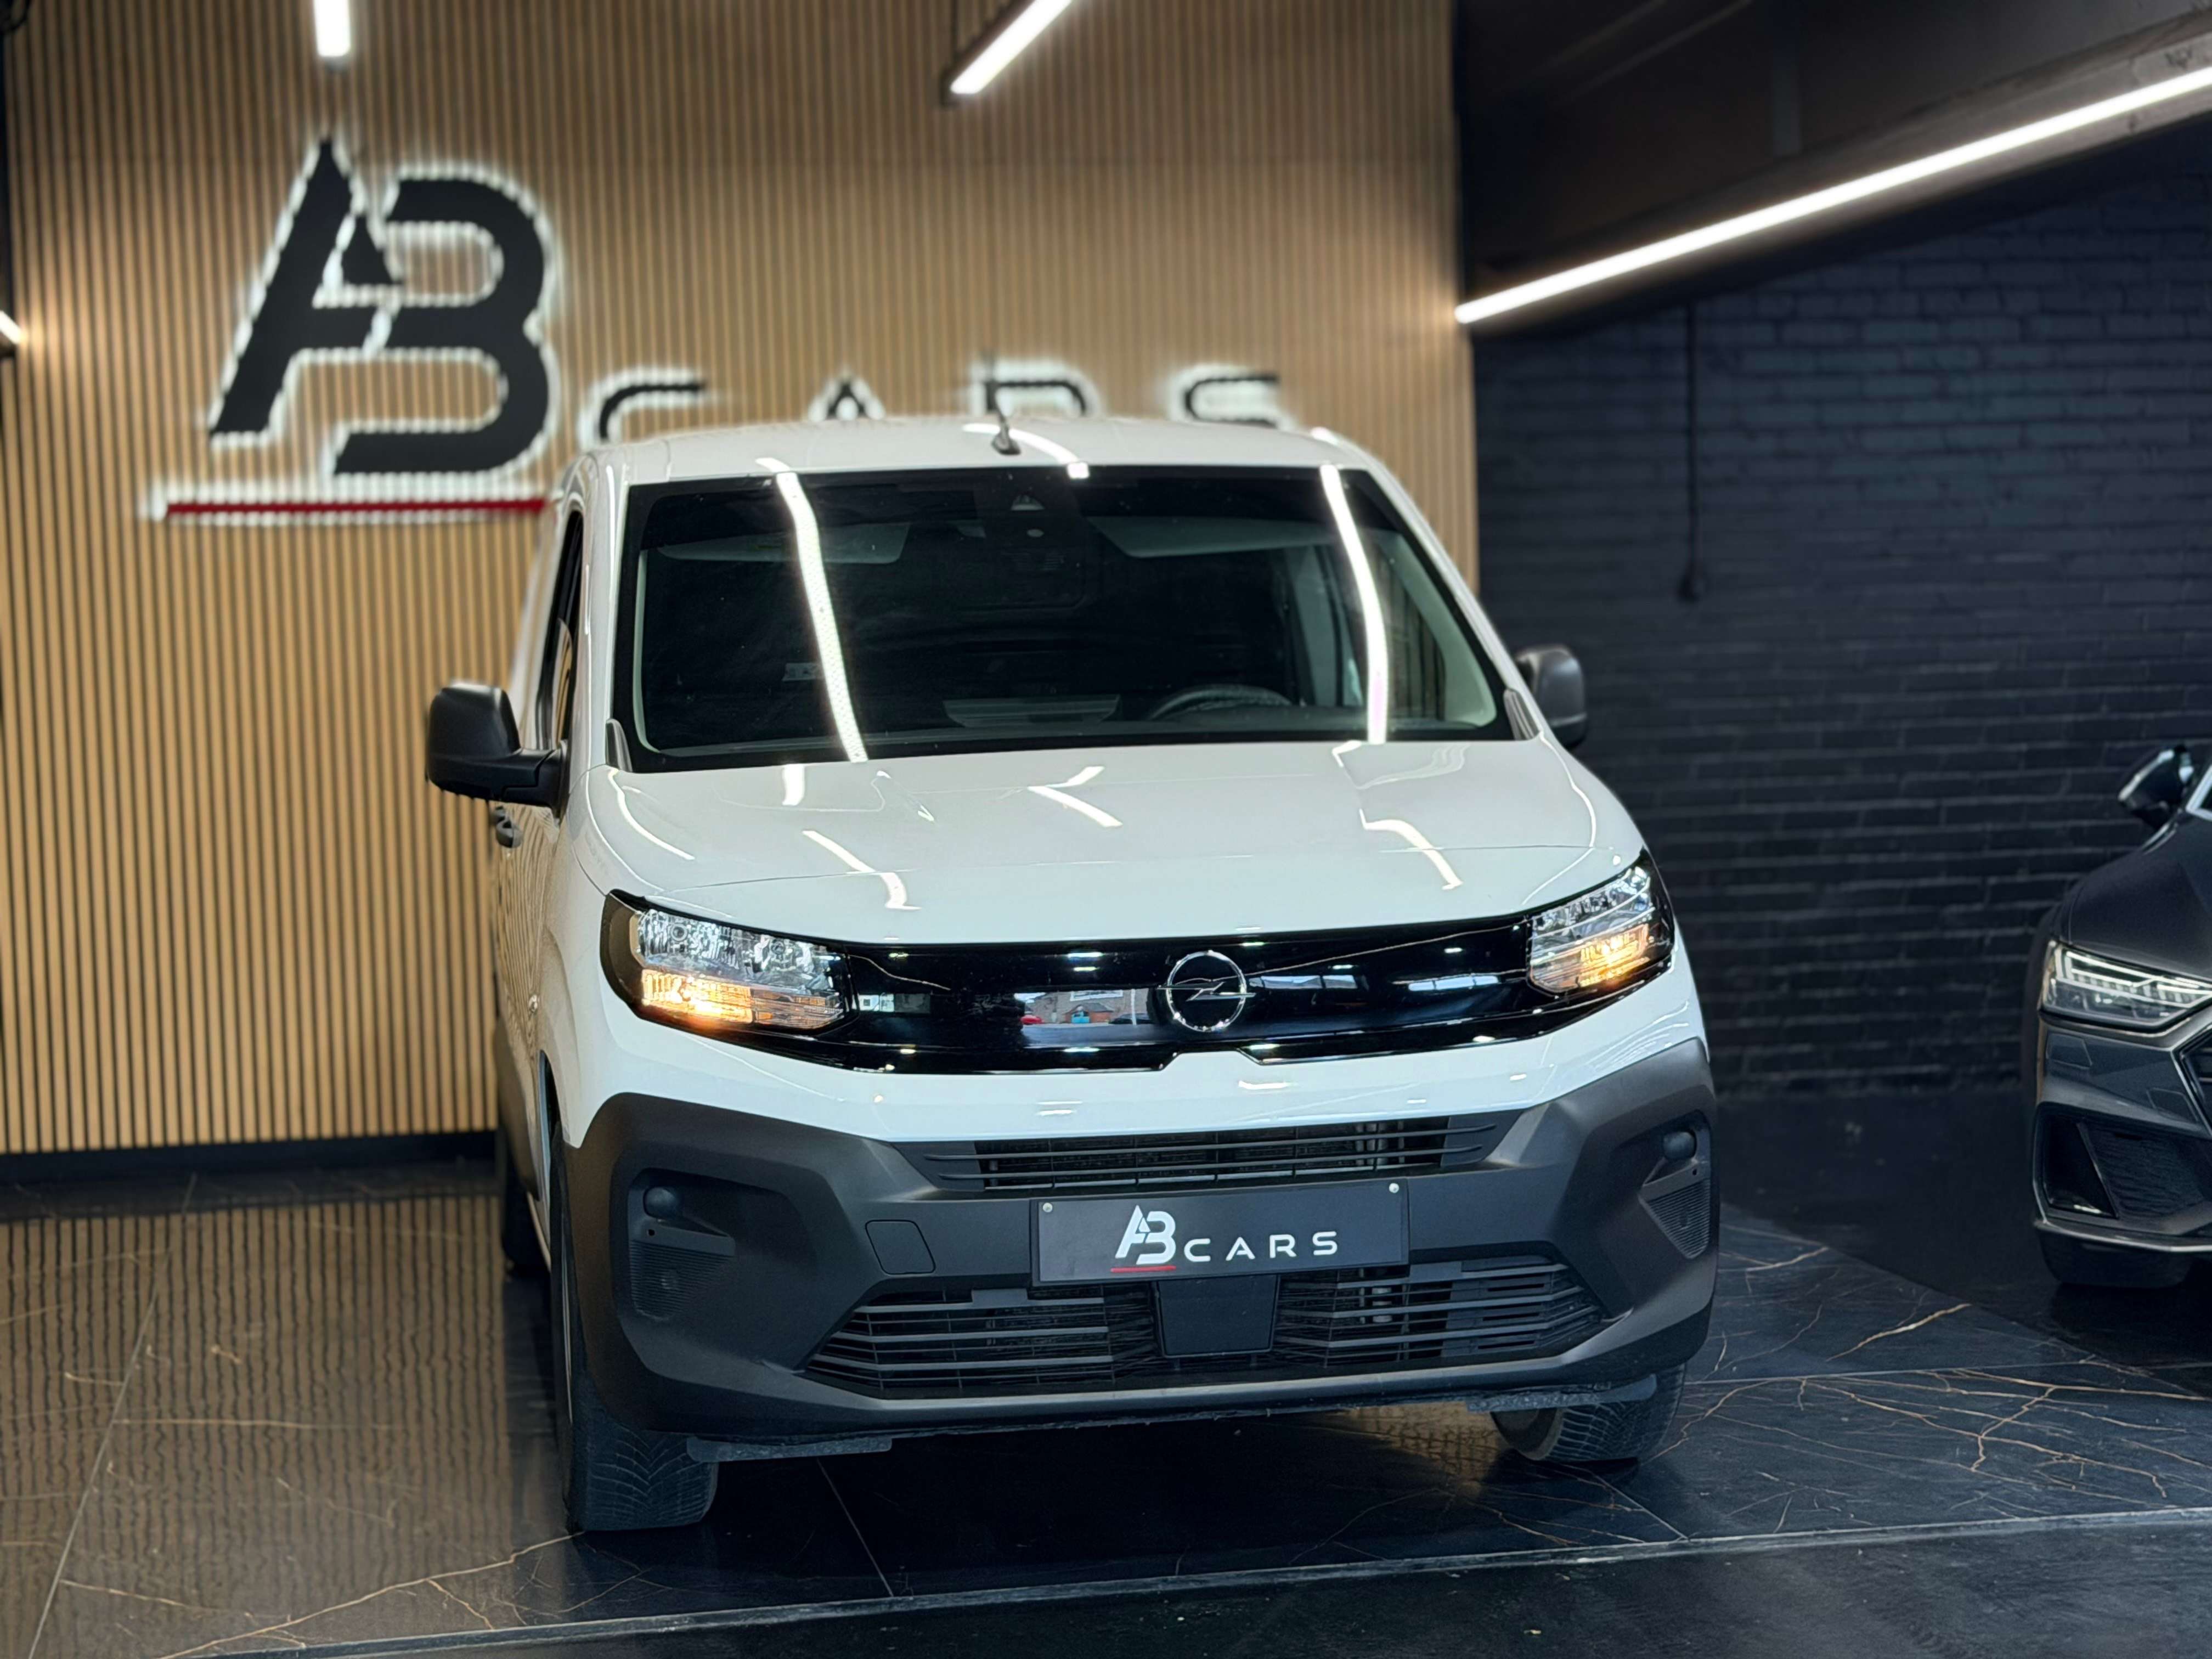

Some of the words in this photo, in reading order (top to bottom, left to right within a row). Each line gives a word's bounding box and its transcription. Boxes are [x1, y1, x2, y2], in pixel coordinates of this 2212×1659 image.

[208, 137, 549, 475] AB
[1114, 1204, 1177, 1266] AB
[1183, 1231, 1339, 1263] CARS
